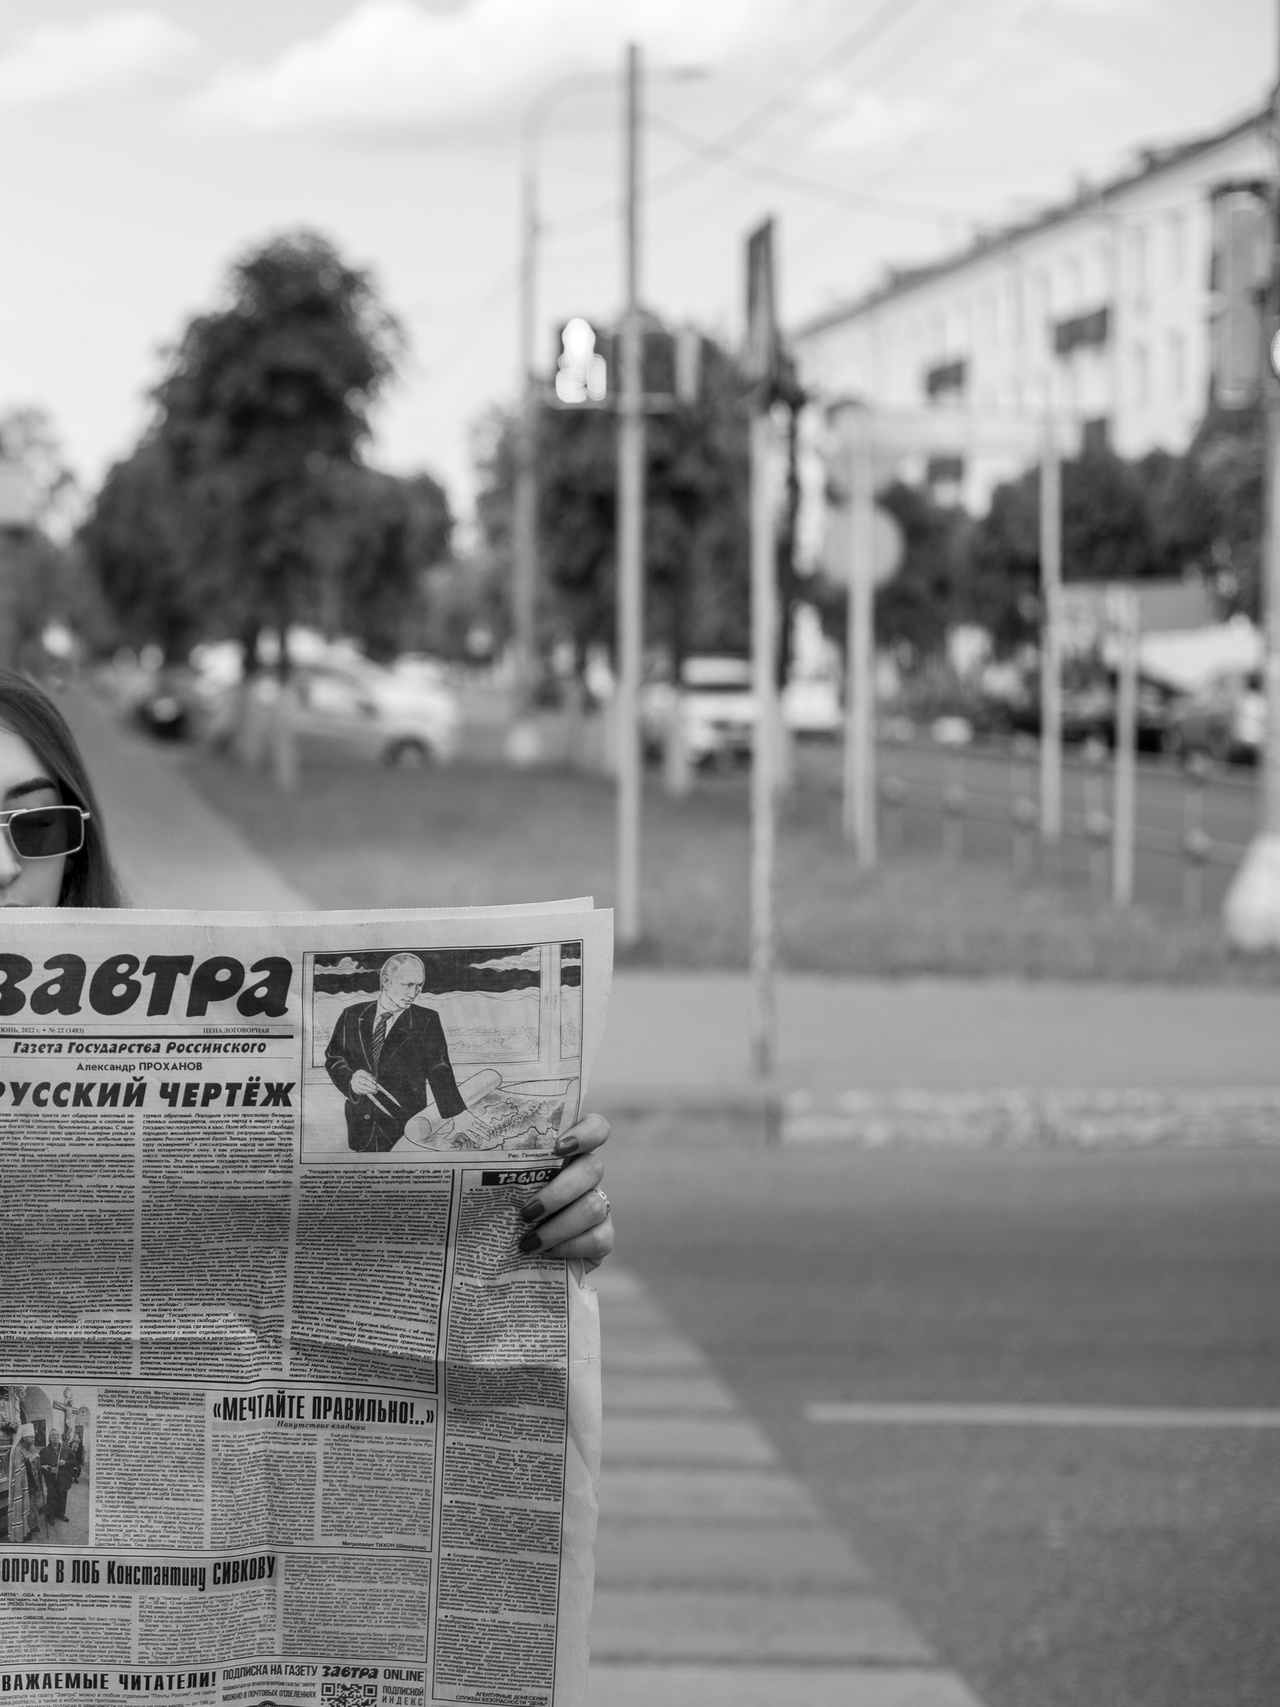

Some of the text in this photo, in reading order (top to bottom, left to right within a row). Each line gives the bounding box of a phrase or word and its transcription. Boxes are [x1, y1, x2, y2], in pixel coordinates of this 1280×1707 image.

[13, 1042, 266, 1054] Газета Государства Российского
[77, 1062, 203, 1072] Александр ПРОХАНОВ
[159, 1076, 296, 1107] ЧЕРТЁЖ
[213, 1390, 434, 1425] «МЕЧТАЙТЕ ПРАВИЛЬНО!..»
[277, 1421, 329, 1430] Напутствие
[56, 1560, 64, 1583] В
[72, 1560, 100, 1584] ЛОБ
[108, 1560, 206, 1591] Константину
[213, 1556, 275, 1585] СИВКОВУ
[223, 1665, 318, 1680] ПОДПИСКА НА ГАЗЕТУ
[384, 1669, 424, 1682] ONLINE
[119, 1672, 216, 1691] ЧИТАТЕЛИ!
[223, 1693, 242, 1701] МОЖНО
[279, 1690, 316, 1698] ОТДЕЛЕНИЯХ
[383, 1685, 424, 1696] ПОДПИСНОЙ
[382, 1696, 423, 1706] ИНДЕКС
